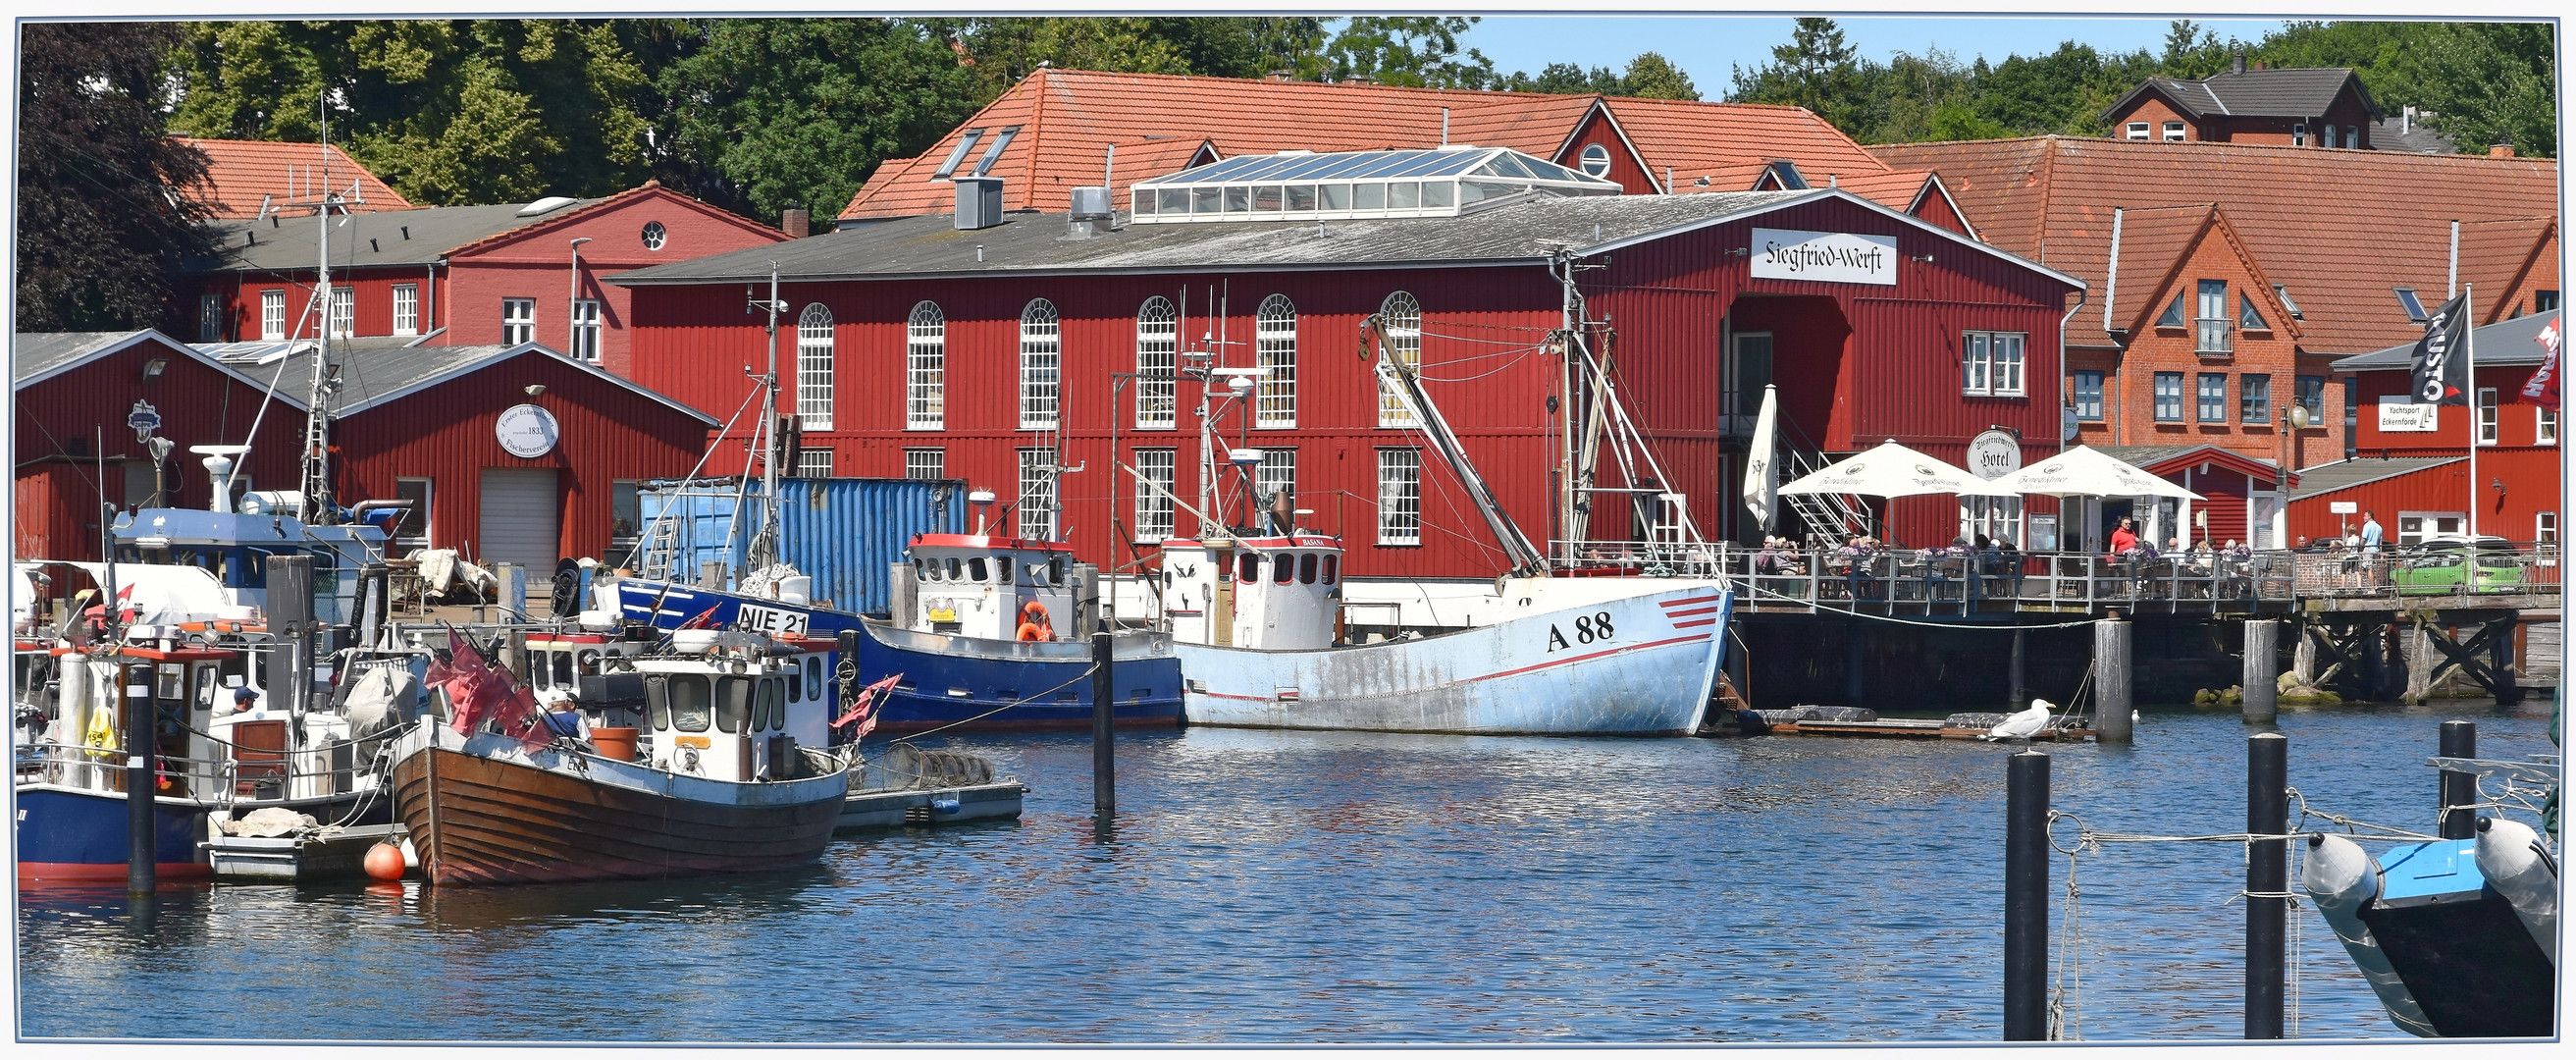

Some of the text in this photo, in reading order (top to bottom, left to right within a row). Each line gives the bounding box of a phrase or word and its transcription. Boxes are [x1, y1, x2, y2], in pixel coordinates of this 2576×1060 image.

[1765, 240, 1882, 275] Siegfried-Werft
[2390, 406, 2420, 415] Yachtsport
[501, 412, 518, 428] Erster
[2382, 417, 2417, 426] Eckernförde
[528, 426, 544, 436] 1833
[506, 439, 550, 453] Fischerverein
[1980, 450, 2010, 470] Hotel
[739, 607, 808, 635] NIE 21
[1547, 611, 1614, 654] A 88
